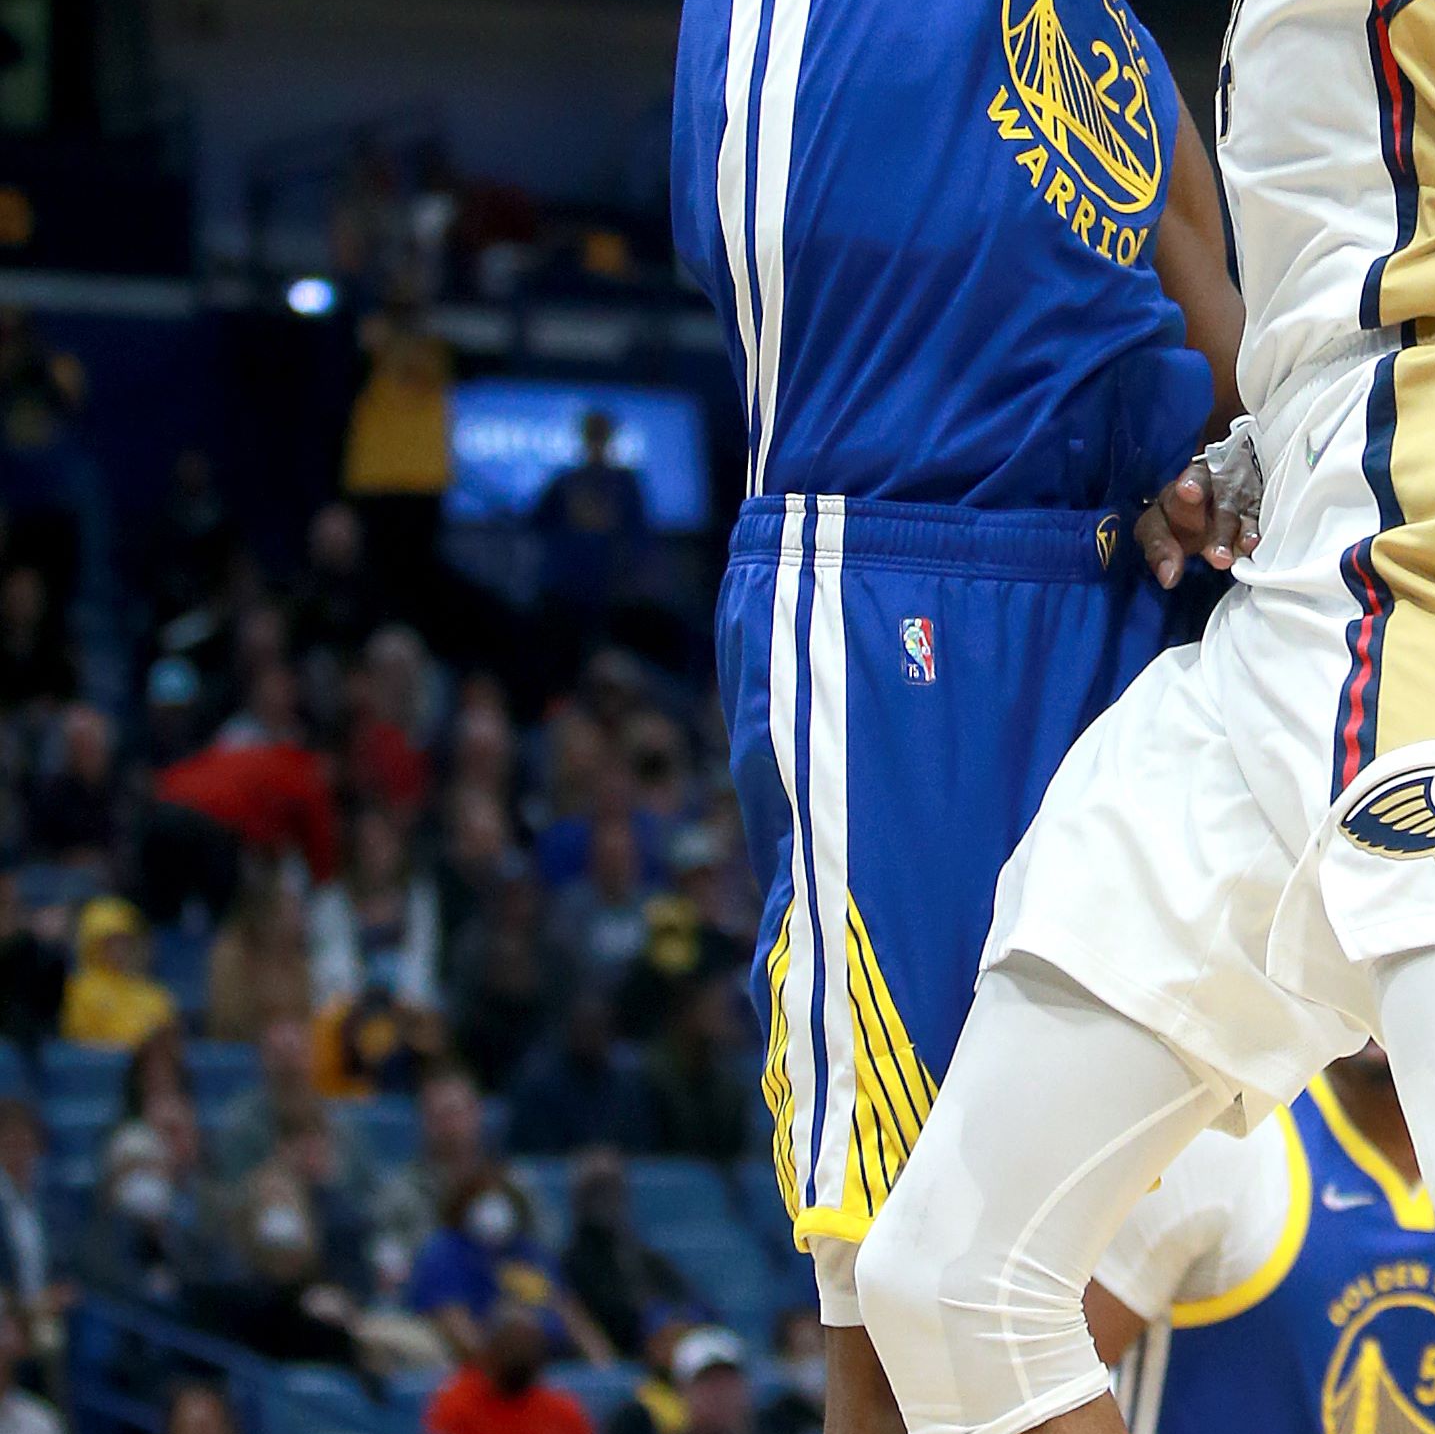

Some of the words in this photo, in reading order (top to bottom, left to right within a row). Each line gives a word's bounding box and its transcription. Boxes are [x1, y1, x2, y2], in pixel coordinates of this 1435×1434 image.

[1091, 40, 1149, 140] 22
[986, 84, 1150, 266] WARRIO
[1327, 1262, 1430, 1327] GOLDEN
